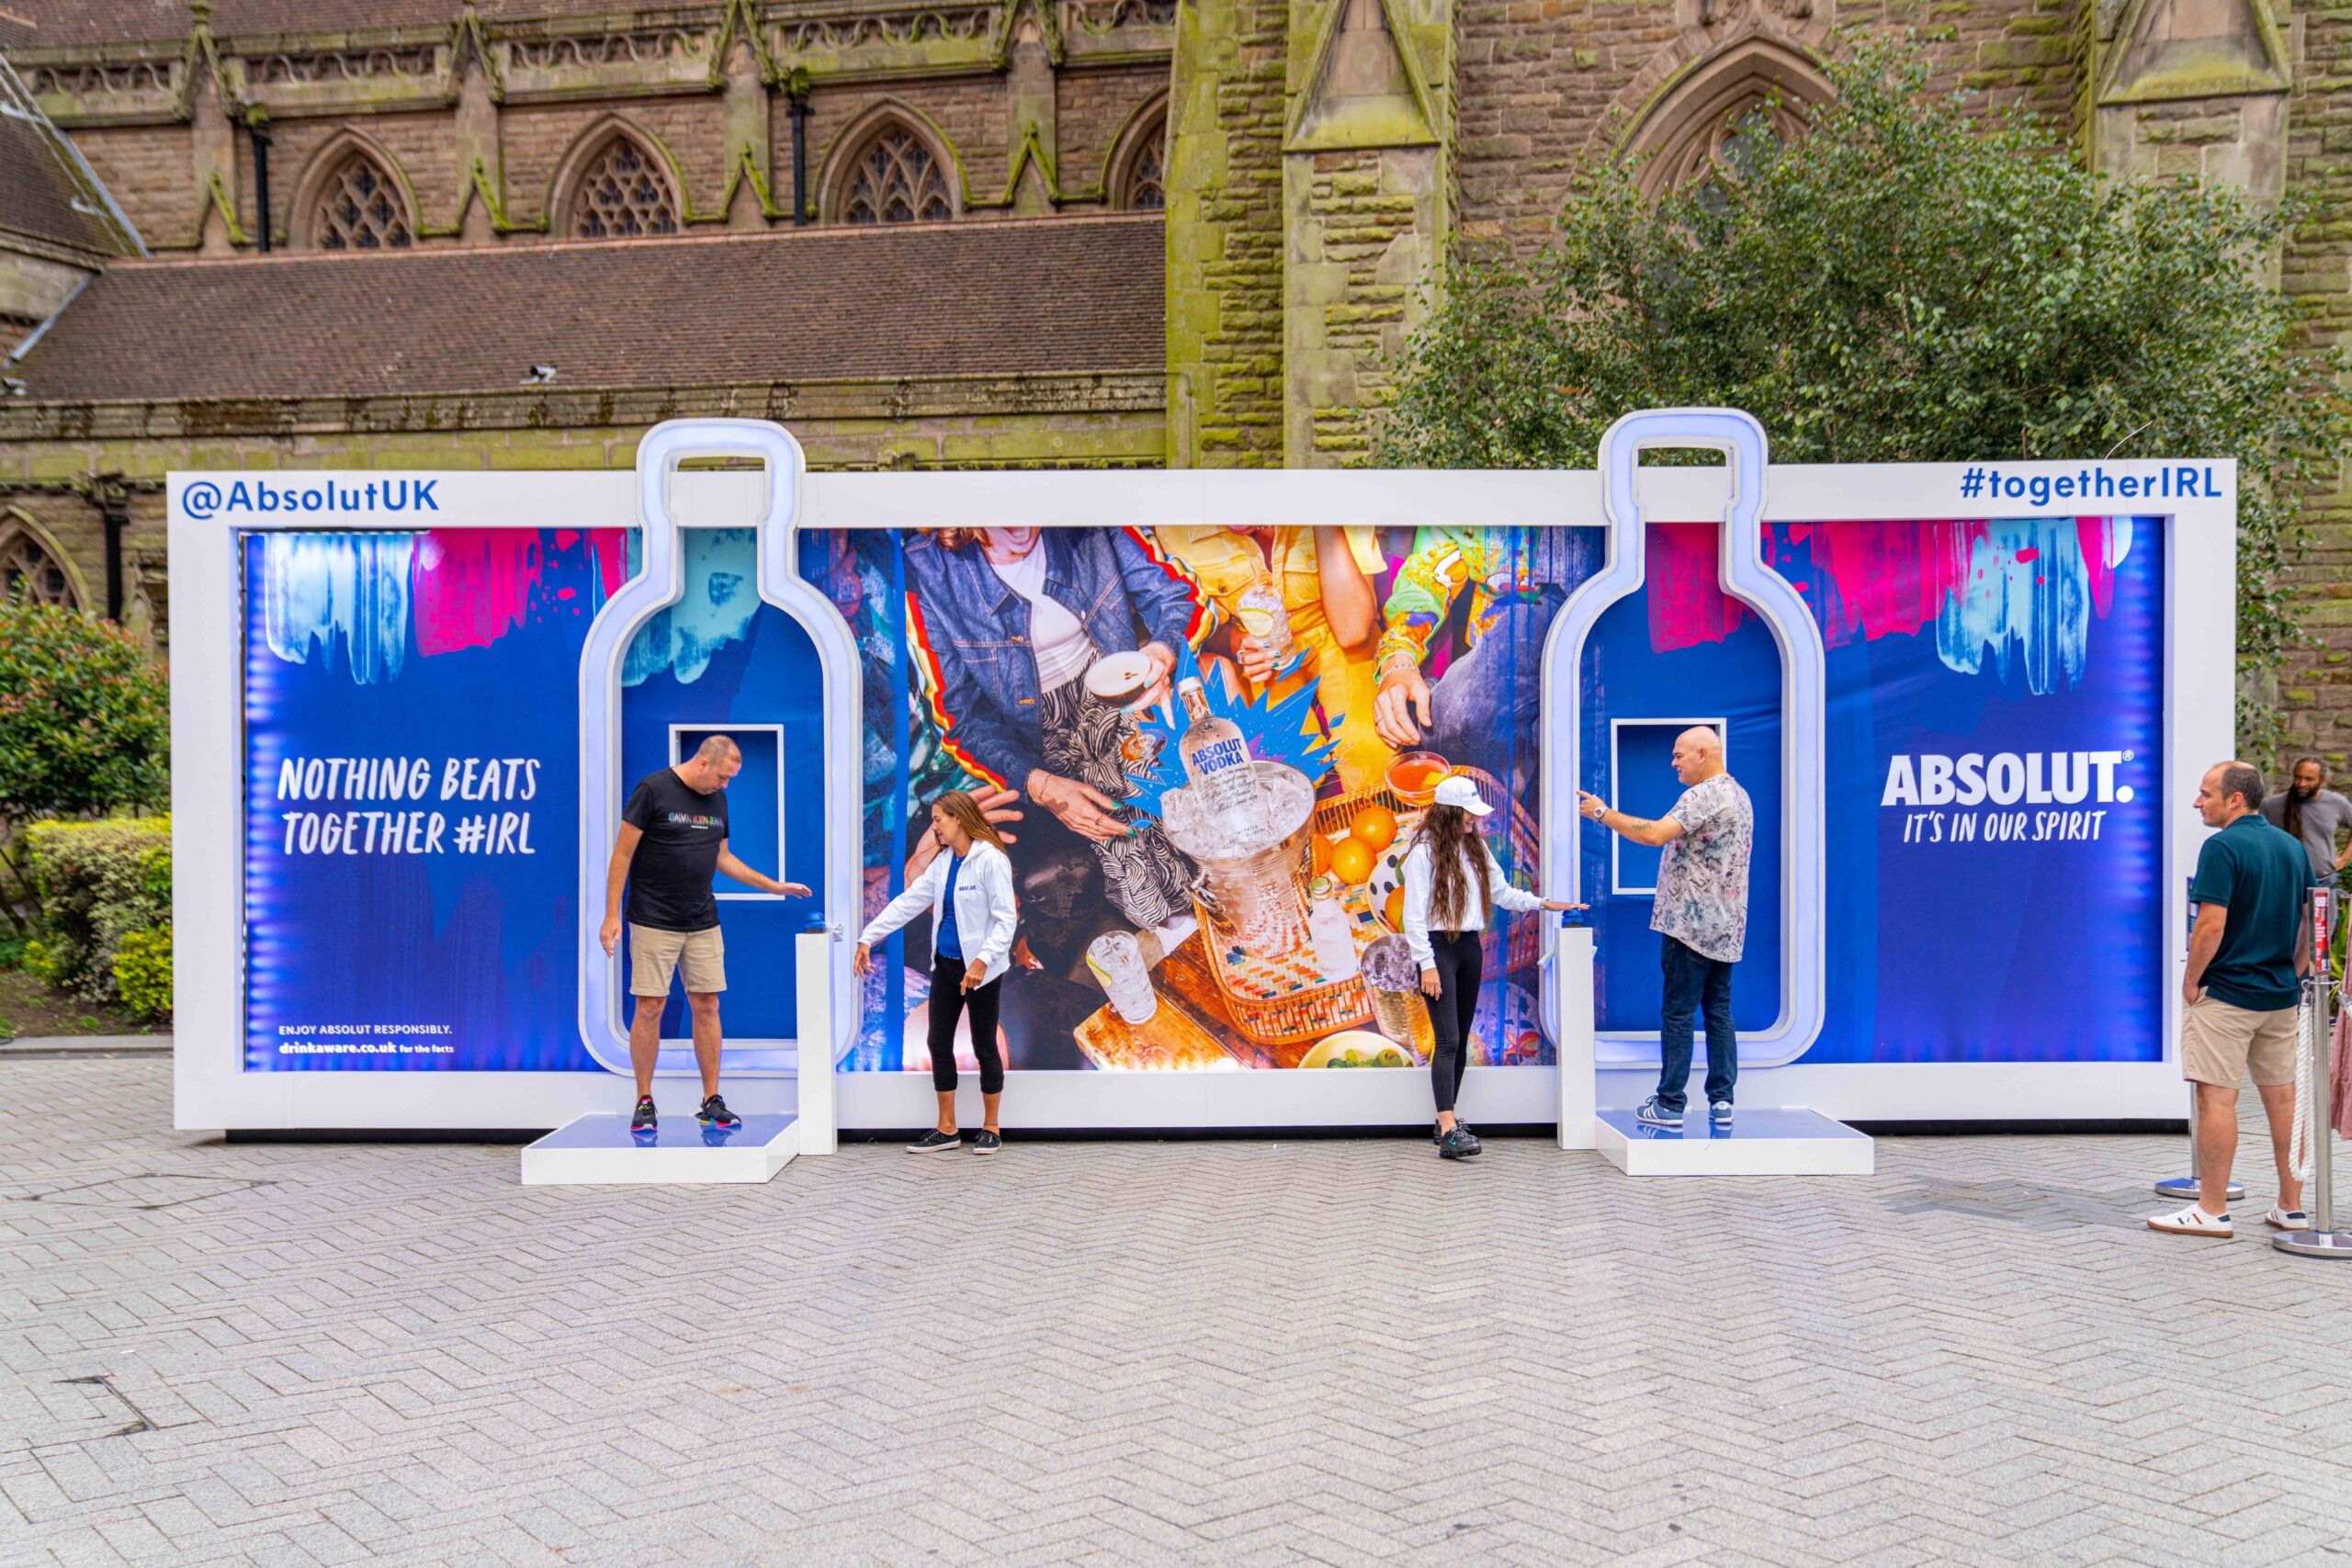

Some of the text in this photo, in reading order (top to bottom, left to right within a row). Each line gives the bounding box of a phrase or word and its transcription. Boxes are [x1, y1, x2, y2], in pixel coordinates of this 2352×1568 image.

[183, 480, 439, 520] @AbsolutUK
[1961, 467, 2222, 506] #togetherIRL
[1192, 738, 1241, 766] ABSOLUT
[1199, 751, 1244, 775] VODKA
[277, 757, 540, 801] NOTHING BEATS
[282, 811, 536, 854] TOGETHER #IRL
[1904, 810, 2107, 842] IT'S IN OUR SPIRIT
[278, 1025, 452, 1035] ENJOY ABSOLUT RESPONSIBLY.
[279, 1042, 455, 1054] drinkaware.co.uk for the facts
